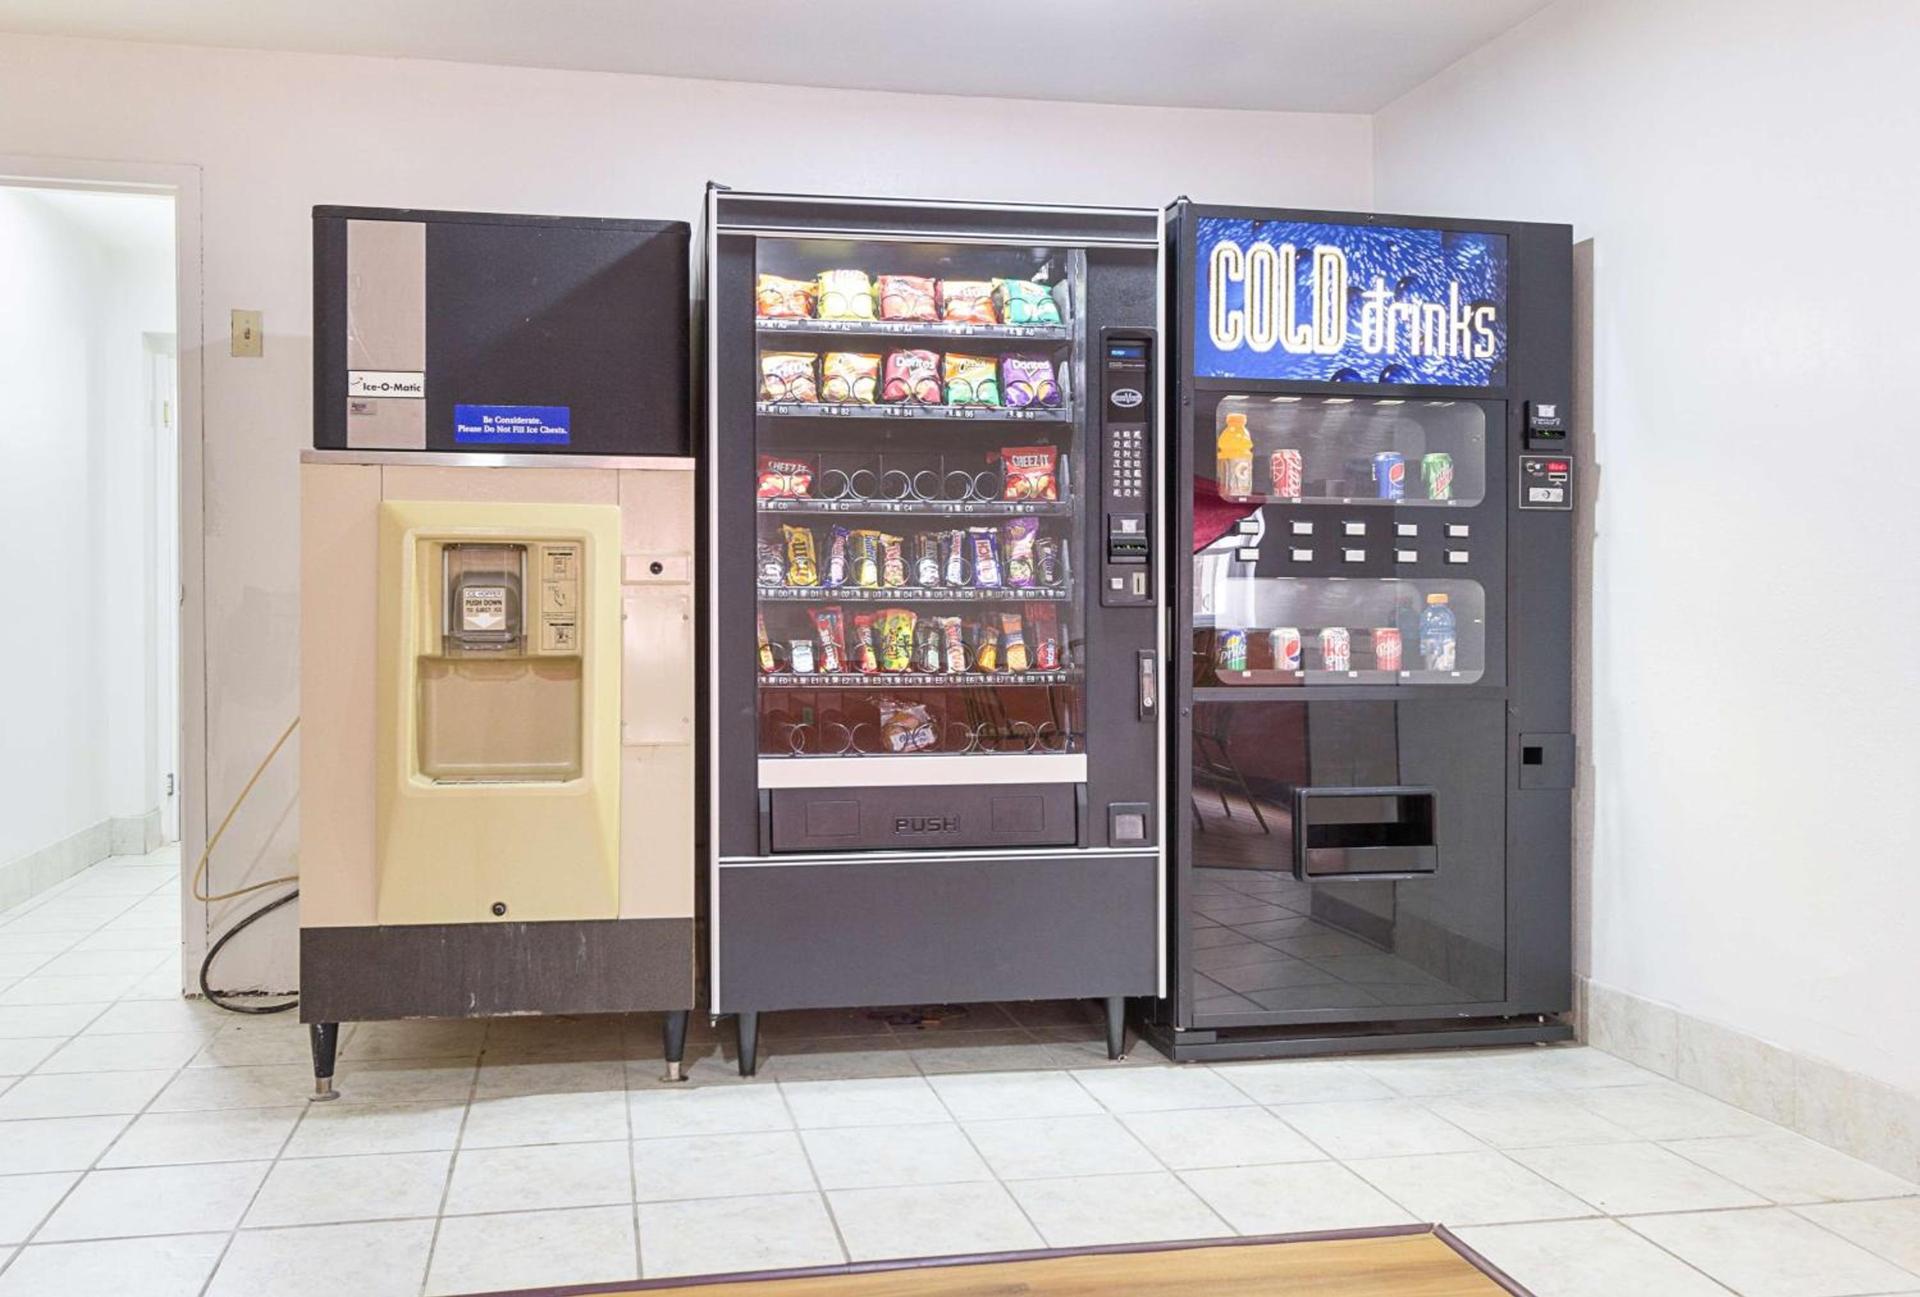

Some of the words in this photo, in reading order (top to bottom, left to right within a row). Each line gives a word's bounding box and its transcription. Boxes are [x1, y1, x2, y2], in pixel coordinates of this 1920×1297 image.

[1209, 240, 1348, 355] COLD
[1361, 277, 1496, 361] drinks
[895, 356, 935, 370] Doritos
[1012, 360, 1049, 369] Doritos
[363, 383, 421, 392] Ice-O-Matic
[483, 416, 493, 424] Be
[457, 425, 482, 433] Please
[484, 425, 495, 433] Do
[497, 425, 511, 433] Not
[512, 425, 525, 434] Fill
[527, 426, 538, 434] Ice
[896, 818, 960, 832] PUSH
